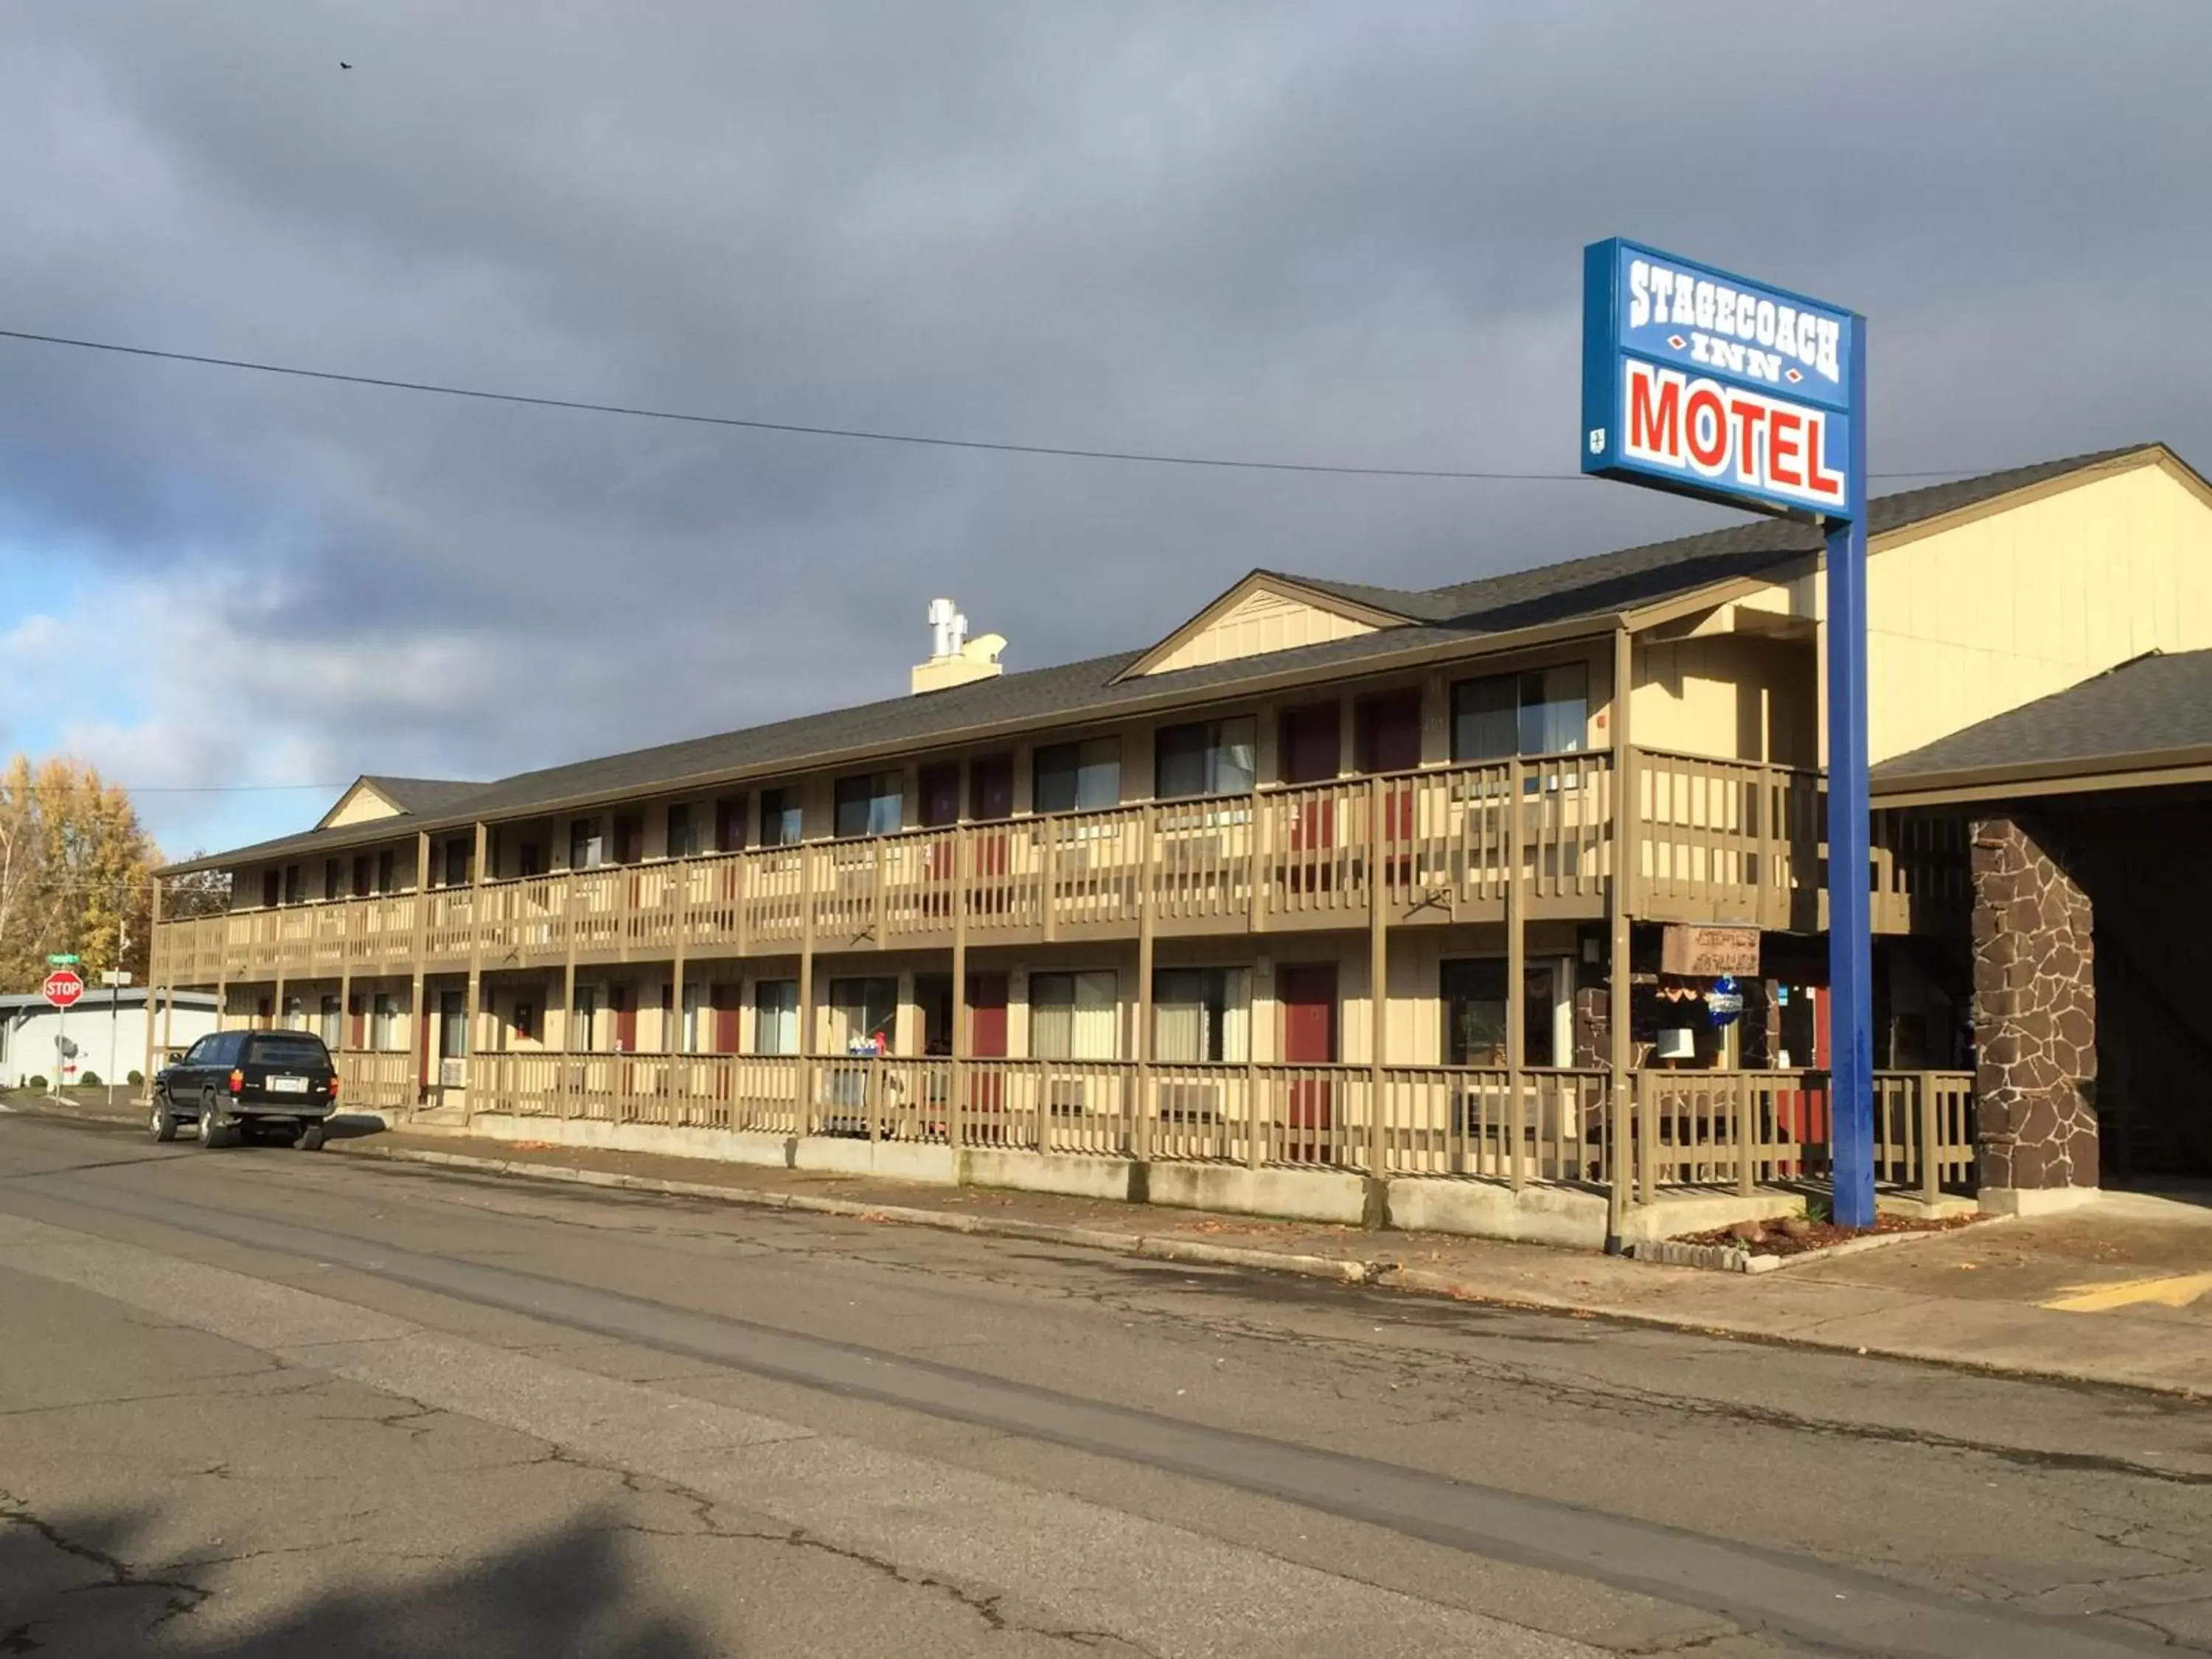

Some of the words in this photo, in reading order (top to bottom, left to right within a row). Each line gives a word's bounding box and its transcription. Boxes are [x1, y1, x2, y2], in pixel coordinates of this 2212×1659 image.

[1630, 260, 1840, 383] STAGECOACH
[1691, 331, 1782, 383] INN
[1629, 369, 1840, 497] MOTEL
[46, 981, 79, 996] STOP
